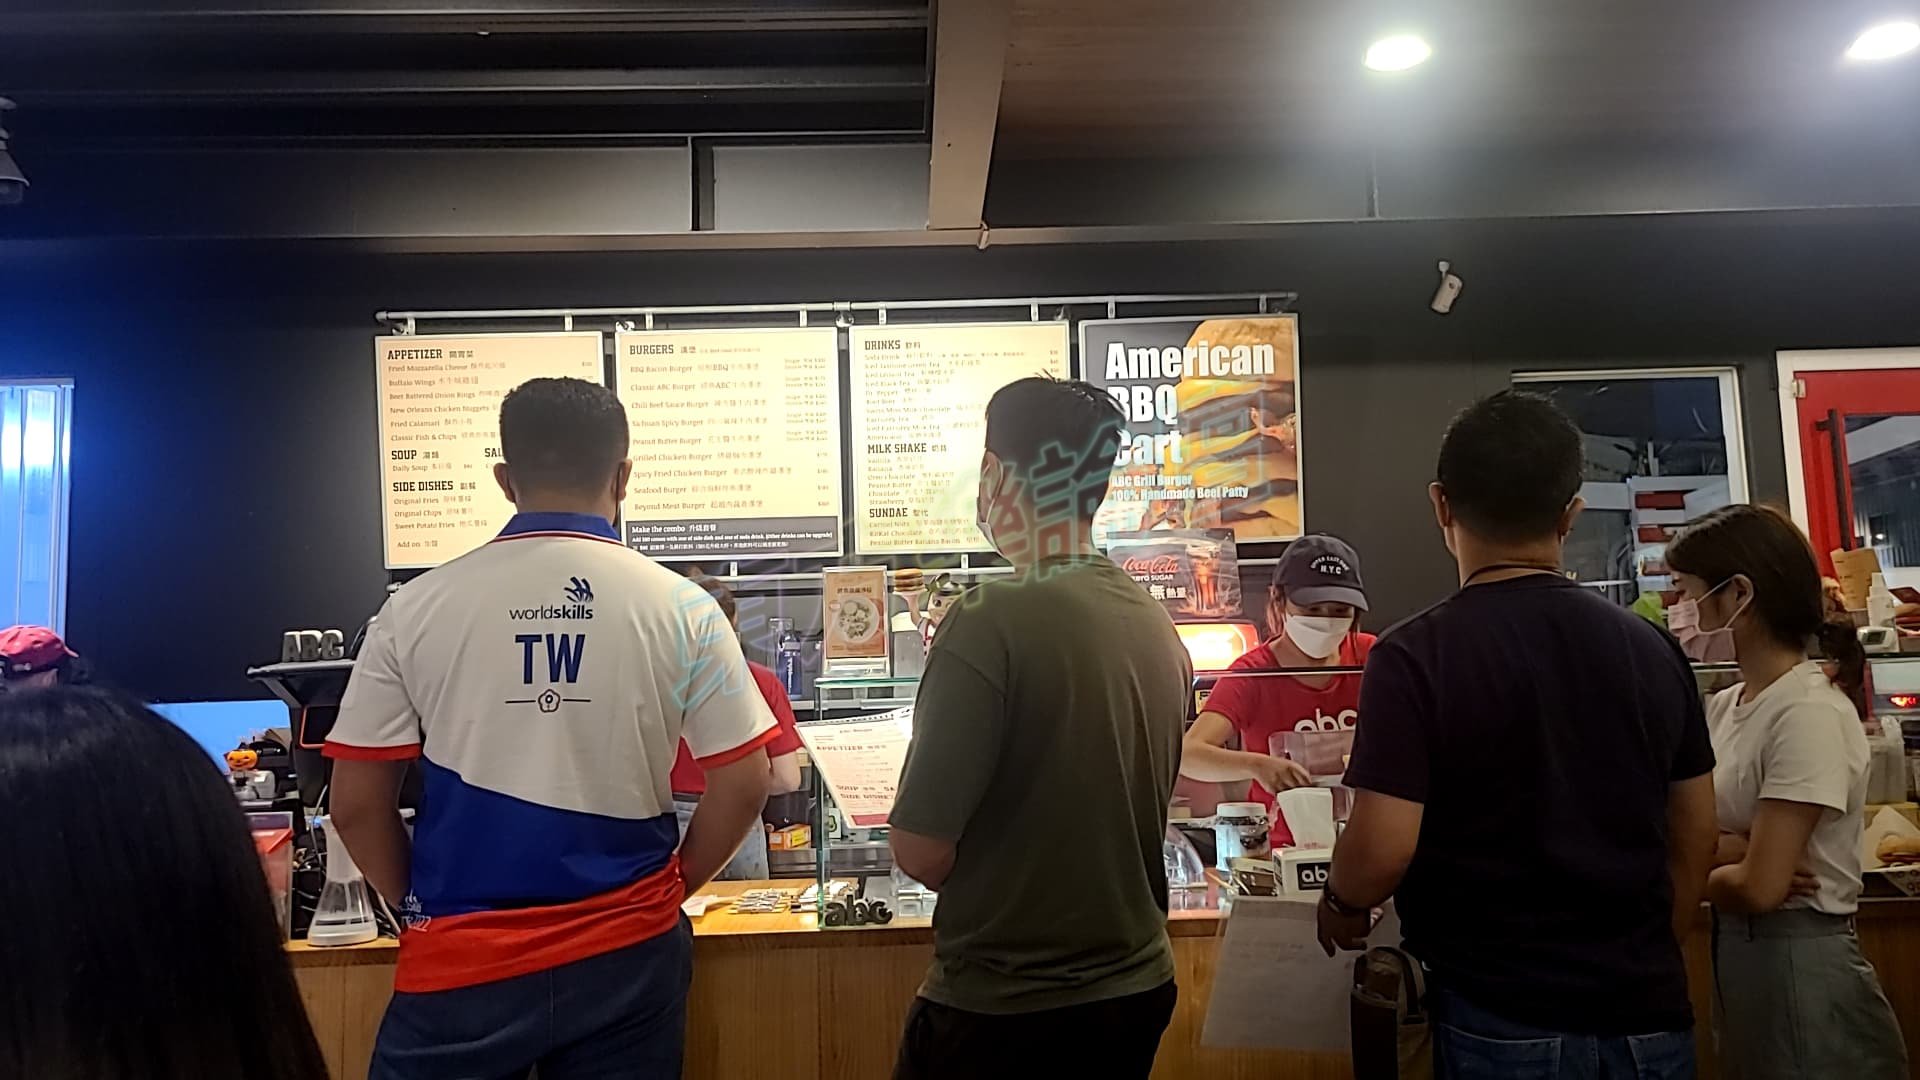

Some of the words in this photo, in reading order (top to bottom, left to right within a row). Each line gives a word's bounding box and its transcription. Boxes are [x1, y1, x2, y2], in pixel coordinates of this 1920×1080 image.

[629, 344, 674, 355] BURGERS
[864, 339, 901, 351] DRINKS
[387, 349, 443, 360] APPETIZER
[1105, 340, 1275, 380] American
[669, 365, 692, 374] Burger
[414, 379, 436, 387] Wings
[630, 383, 655, 391] Classic
[656, 383, 671, 391] ABC
[672, 383, 696, 391] Burger
[456, 391, 476, 400] Rings
[434, 405, 461, 413] Chicken
[462, 405, 490, 413] Nuggets
[631, 401, 648, 409] Chili
[649, 400, 664, 408] Beef
[665, 400, 685, 408] Sauce
[686, 400, 708, 409] Burger
[390, 420, 408, 428] Fried
[661, 419, 679, 428] Spicy
[680, 419, 704, 428] Burger
[438, 433, 457, 442] Chips
[679, 437, 702, 447] Burger
[867, 443, 892, 454] MILK
[894, 443, 927, 453] SHAKE
[391, 449, 417, 460] SOUP
[633, 454, 657, 462] Grilled
[658, 453, 687, 461] Chicken
[688, 453, 713, 462] Burger
[411, 464, 428, 472] Soup
[633, 471, 652, 479] Spicy
[653, 469, 672, 478] Fried
[673, 469, 702, 478] Chicken
[703, 468, 728, 478] Burger
[1133, 474, 1155, 486] Grill
[1156, 473, 1193, 486] Burger
[392, 481, 416, 492] SIDE
[418, 480, 454, 491] DISHES
[633, 486, 662, 494] Seafood
[663, 485, 687, 495] Burger
[1112, 488, 1139, 501] 100%
[1140, 487, 1196, 500] Handmade
[1197, 486, 1221, 498] Beef
[1222, 485, 1249, 499] Patty
[394, 497, 421, 506] Original
[634, 503, 660, 512] Beyond
[662, 502, 680, 511] Meat
[681, 502, 706, 512] Burger
[394, 510, 422, 519] Original
[423, 510, 442, 518] Chips
[869, 507, 908, 518] SUNDAE
[395, 522, 415, 530] Sweet
[416, 521, 438, 529] Potato
[438, 521, 455, 529] Fries
[631, 526, 651, 534] Make
[651, 525, 662, 533] the
[663, 525, 686, 533] combo
[509, 604, 593, 620] worldskills
[282, 629, 344, 663] ABC
[515, 633, 586, 685] TW
[824, 894, 893, 926] abc
